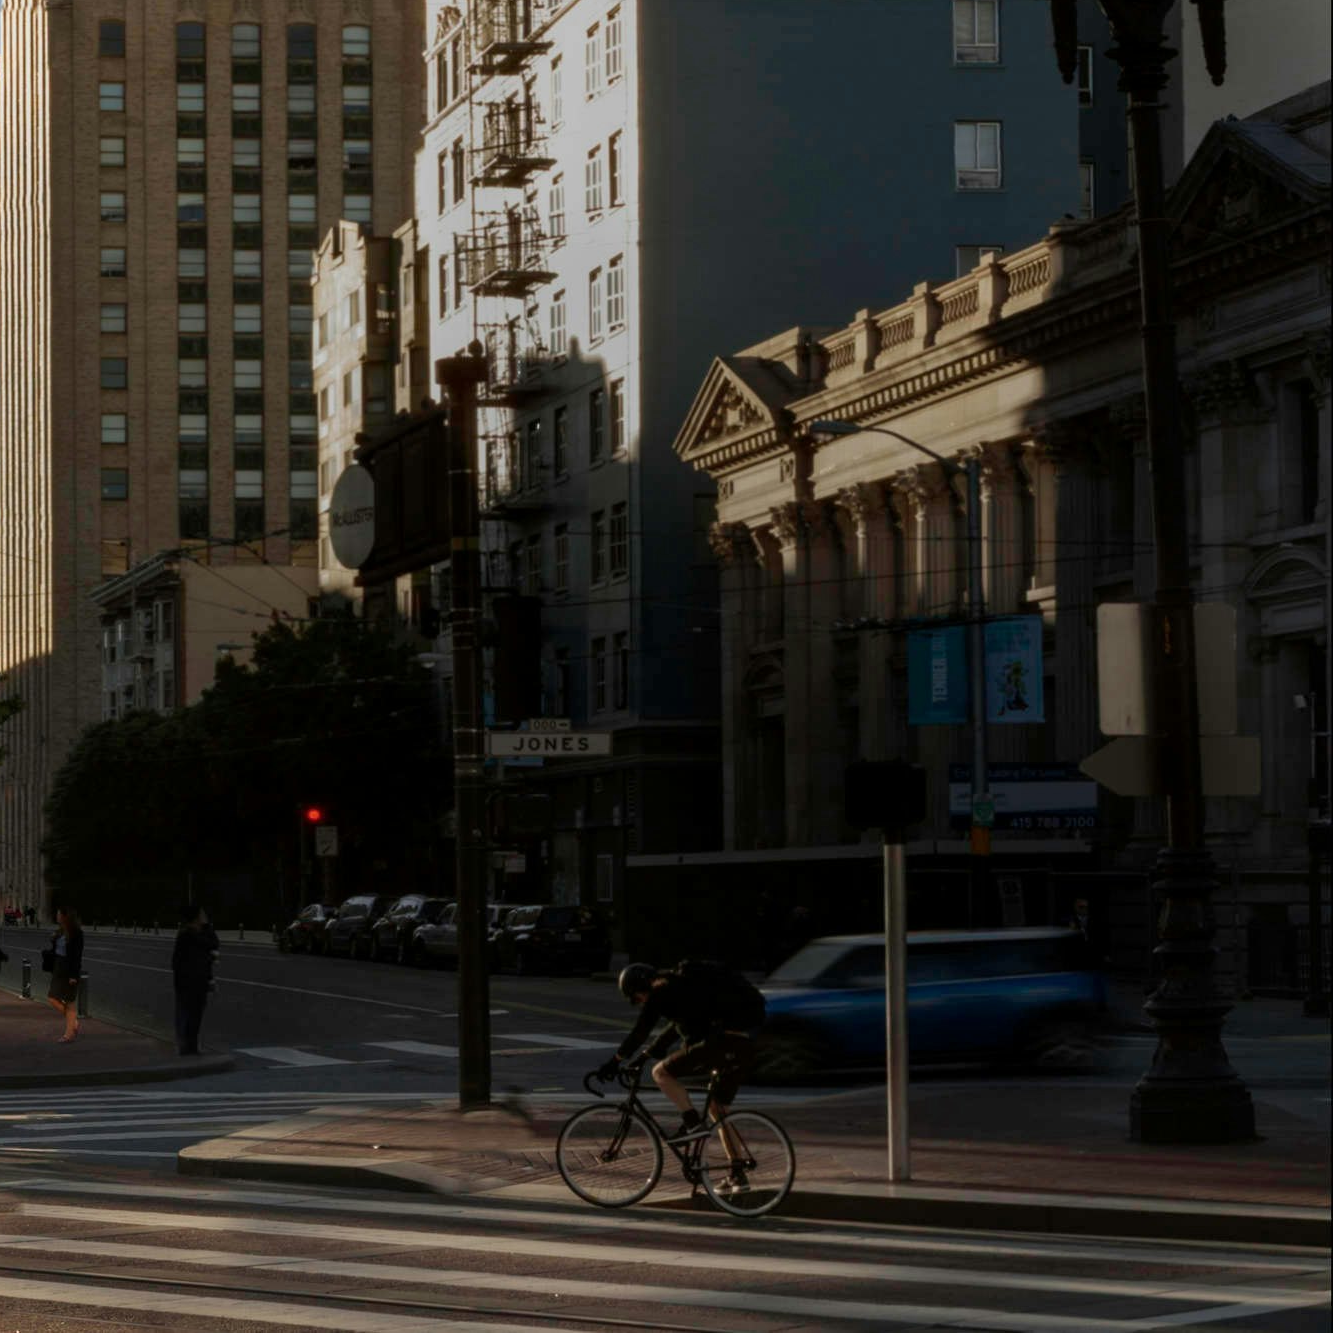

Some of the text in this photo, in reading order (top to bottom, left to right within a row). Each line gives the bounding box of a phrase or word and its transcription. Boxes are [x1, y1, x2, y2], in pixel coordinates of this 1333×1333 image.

[533, 720, 557, 731] 000
[513, 737, 590, 752] JONES
[1011, 817, 1032, 828] 415
